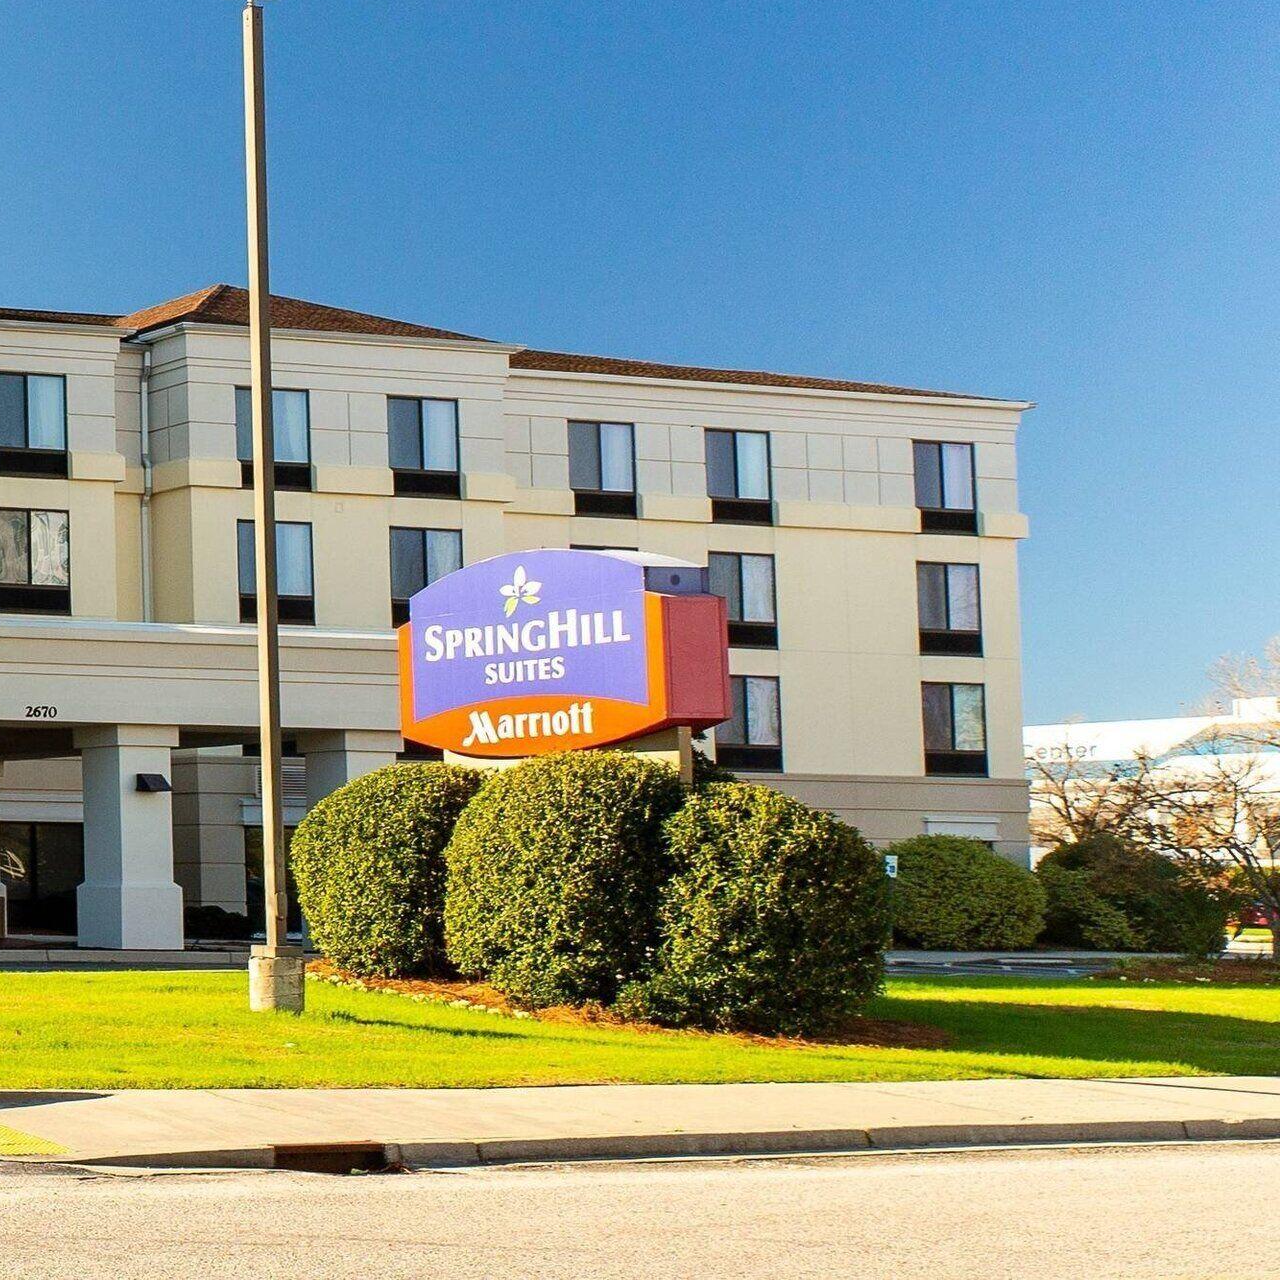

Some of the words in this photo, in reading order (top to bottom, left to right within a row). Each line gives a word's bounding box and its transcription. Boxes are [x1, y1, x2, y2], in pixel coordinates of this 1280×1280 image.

[424, 608, 631, 663] SPRINGHILL
[484, 656, 566, 686] SUITES
[25, 705, 58, 718] 2670
[462, 701, 594, 747] Marriott
